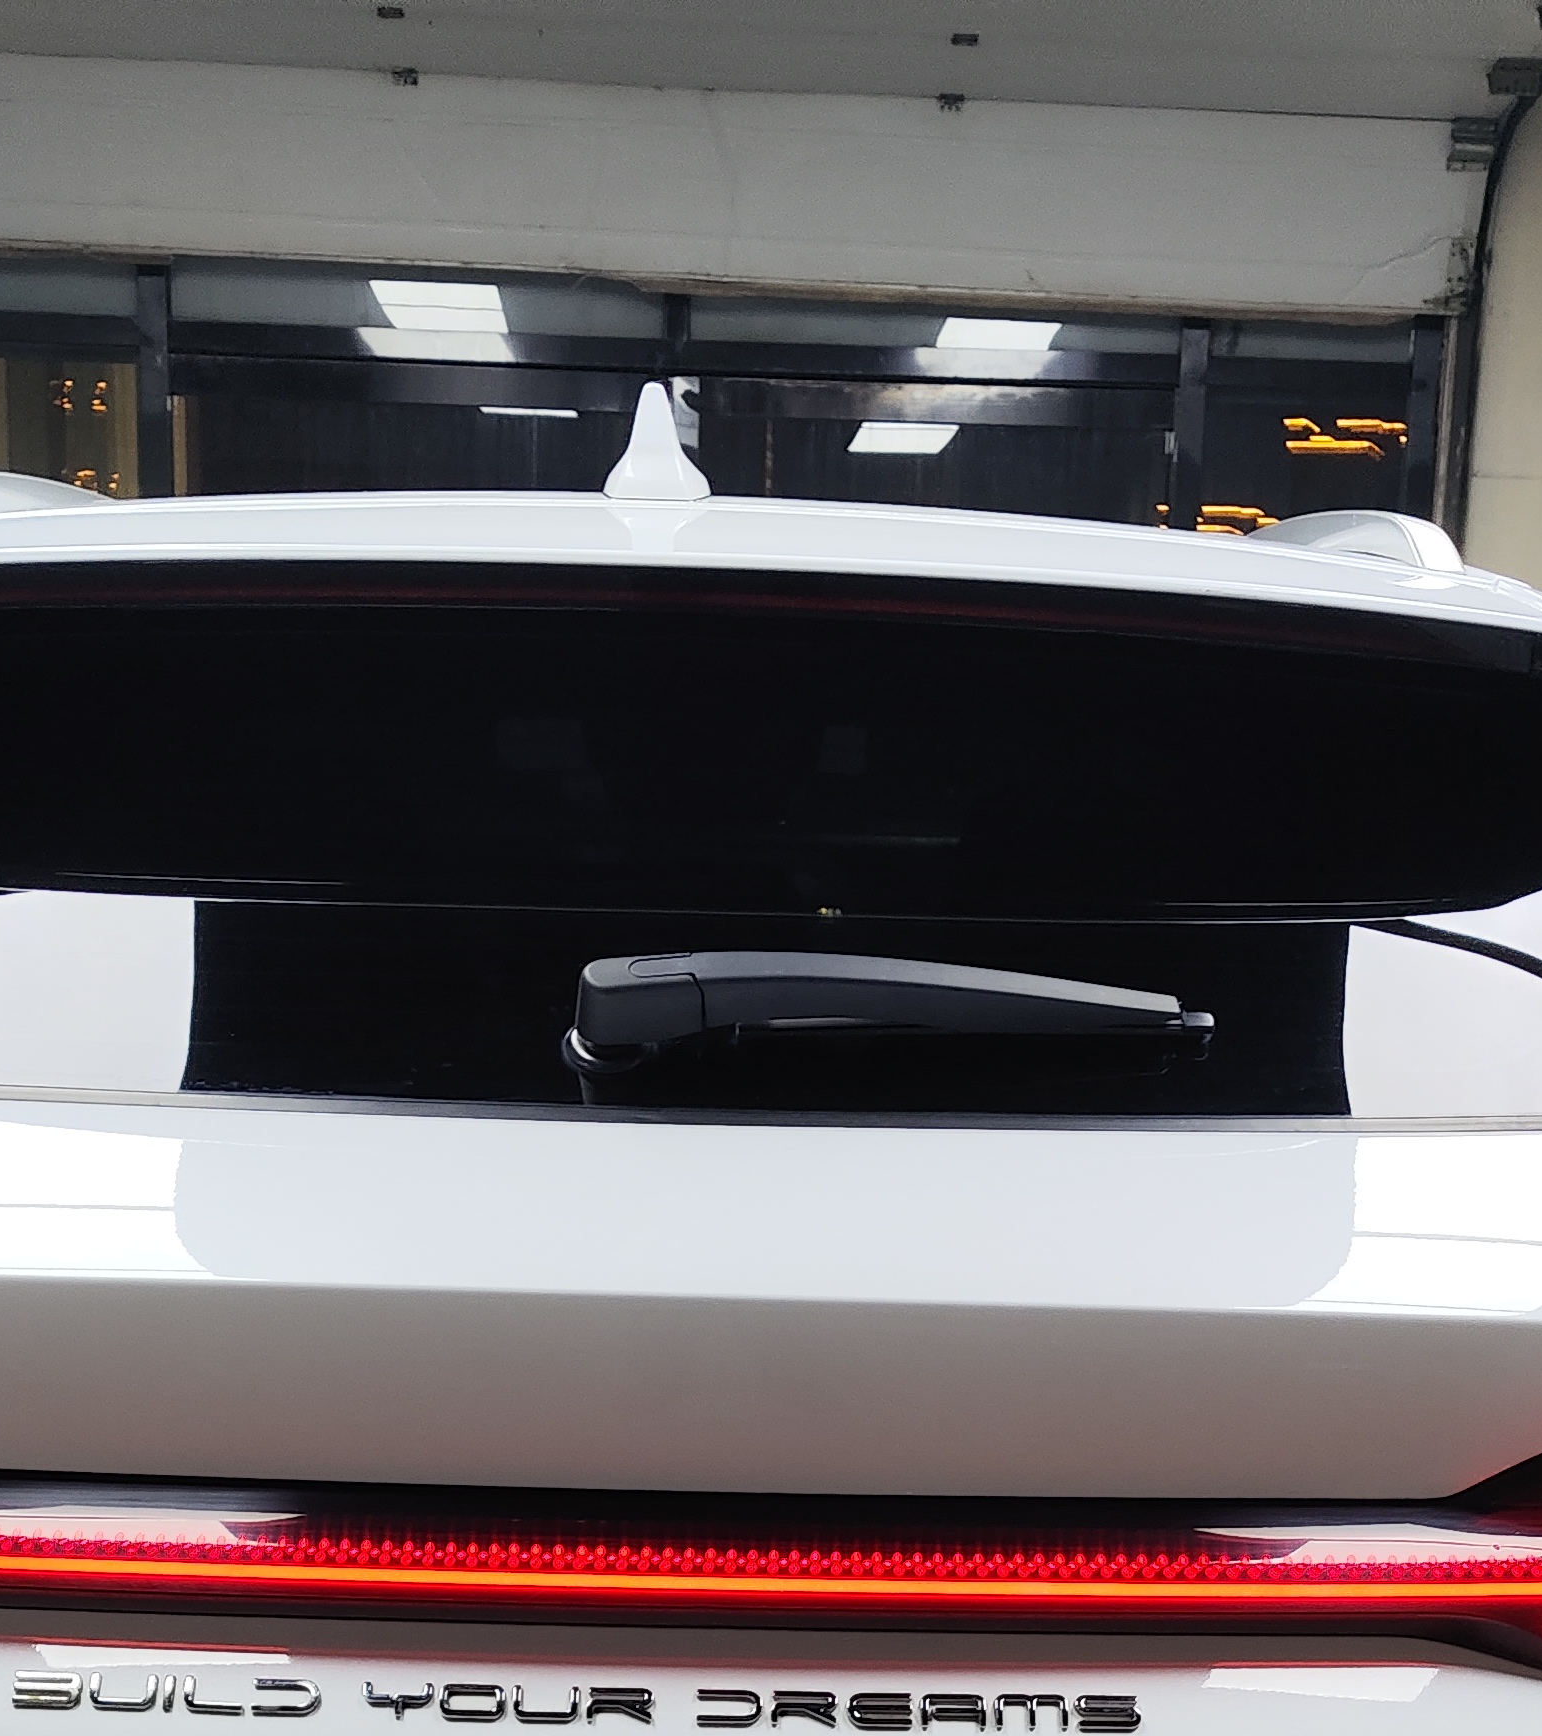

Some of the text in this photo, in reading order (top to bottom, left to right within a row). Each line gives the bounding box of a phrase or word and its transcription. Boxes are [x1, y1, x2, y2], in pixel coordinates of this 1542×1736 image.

[12, 1669, 1142, 1734] BUILD YOUR DREAMS
